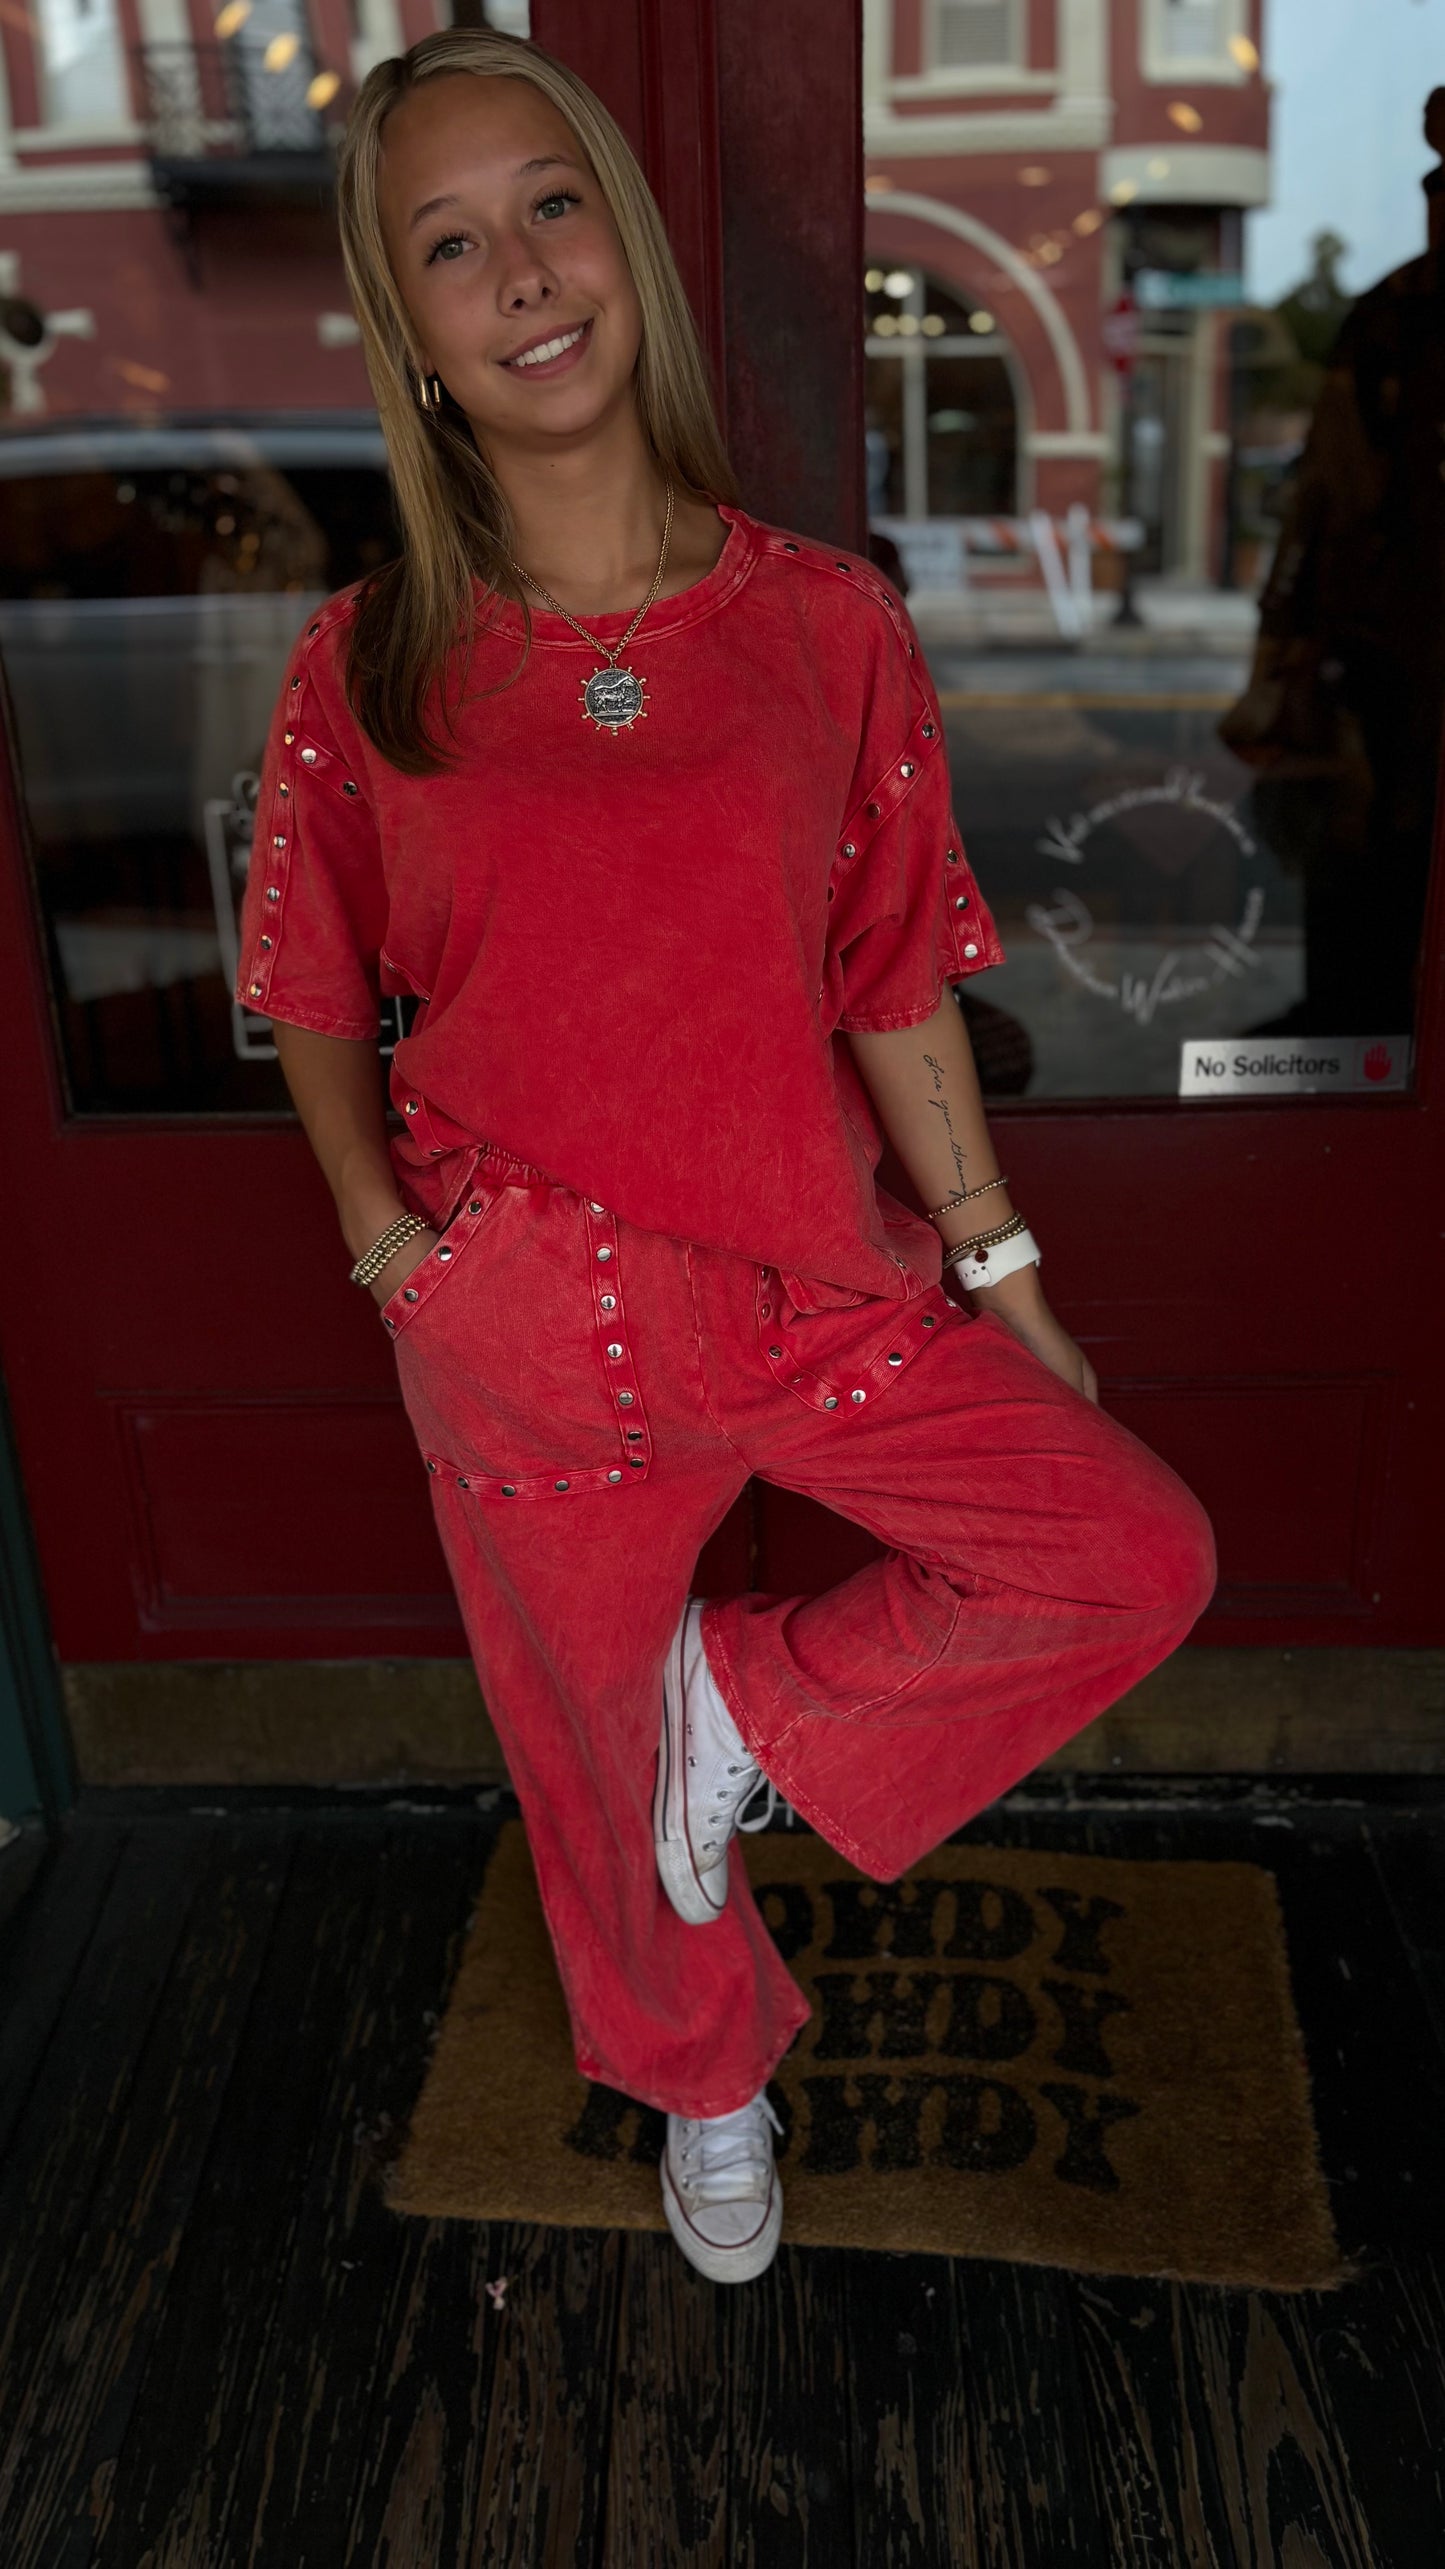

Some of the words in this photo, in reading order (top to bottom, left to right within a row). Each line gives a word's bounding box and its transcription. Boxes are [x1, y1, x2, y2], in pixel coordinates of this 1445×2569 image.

[1194, 1055, 1226, 1077] No
[1233, 1054, 1340, 1076] Solicitors
[756, 1881, 1126, 1972] OWDY
